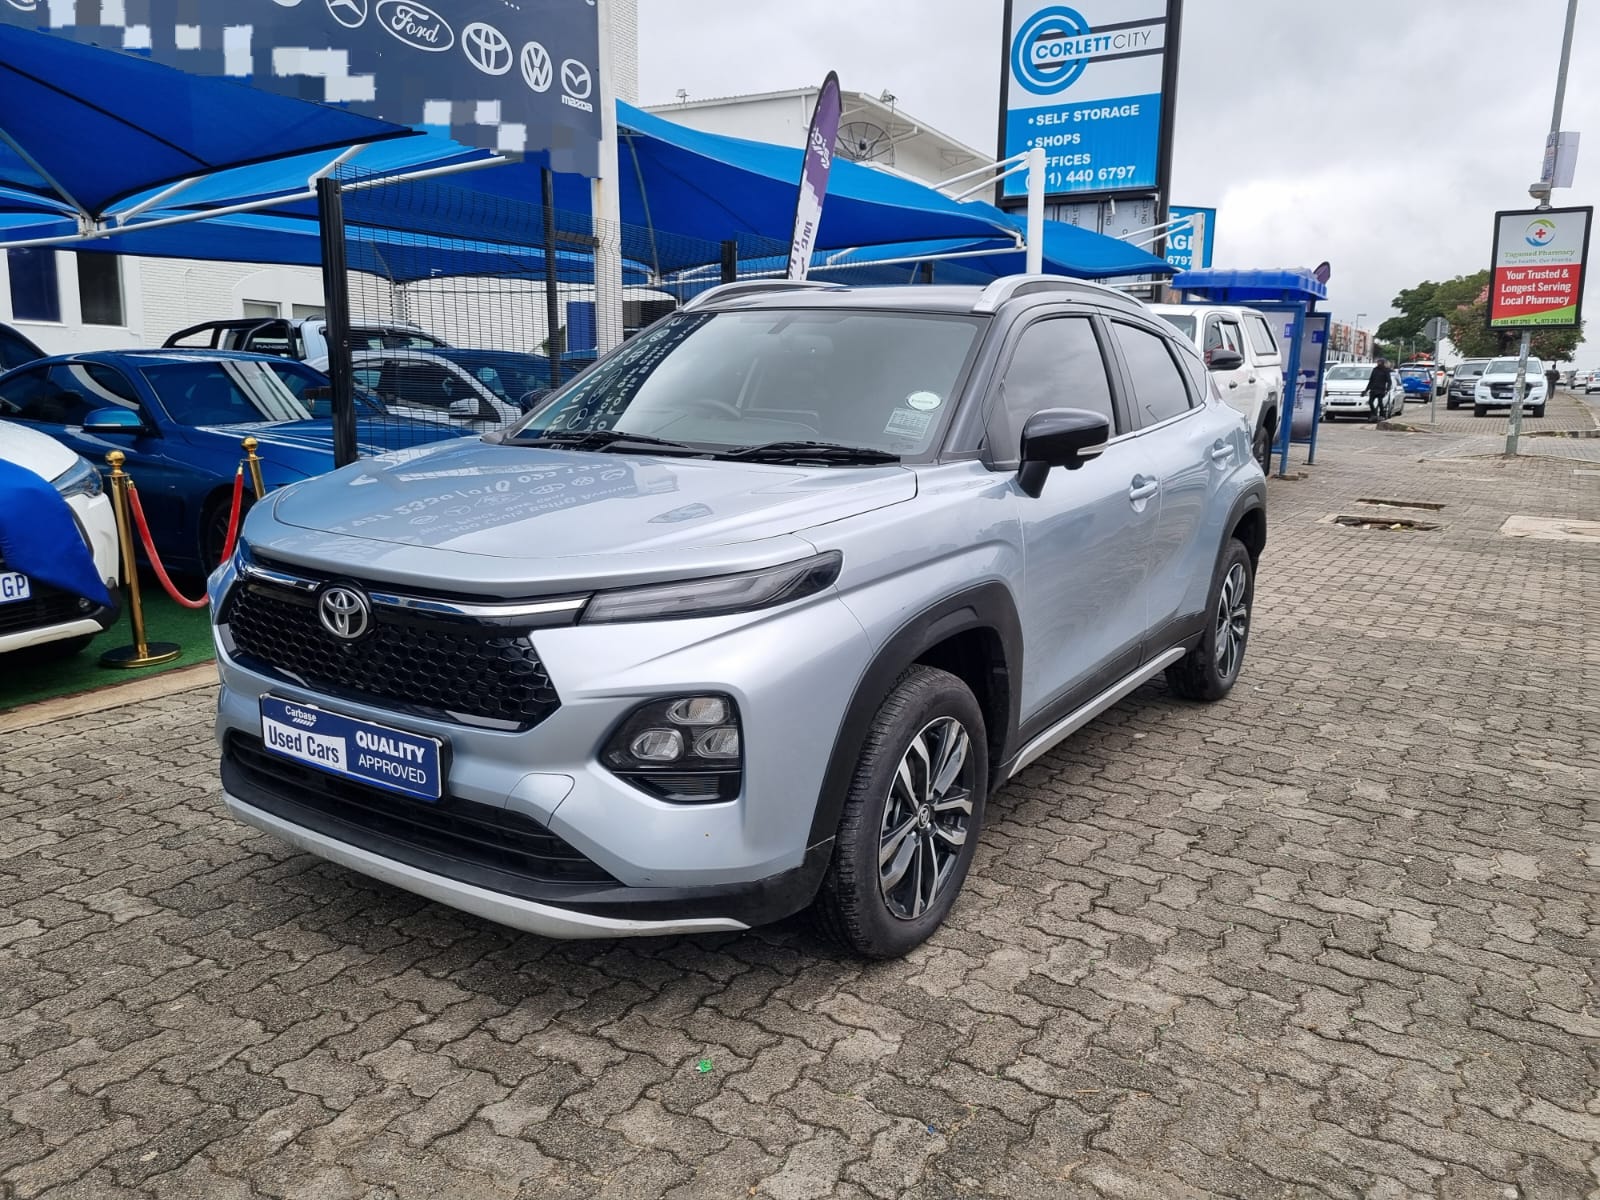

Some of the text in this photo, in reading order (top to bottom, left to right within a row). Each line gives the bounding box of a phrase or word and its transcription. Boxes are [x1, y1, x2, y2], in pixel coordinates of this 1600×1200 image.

[391, 5, 440, 43] Ford
[1036, 104, 1140, 126] SELF STORAGE
[1035, 133, 1081, 148] SHOPS
[1044, 153, 1091, 168] FFICES
[1066, 169, 1093, 183] 440
[1098, 165, 1136, 181] 6797
[1506, 268, 1569, 280] Your Trusted &
[1501, 281, 1572, 295] Longest Serving
[1501, 295, 1570, 306] Local Pharmacy
[2, 574, 26, 598] GP
[285, 705, 317, 722] Carbase
[268, 725, 340, 764] Used Cars
[355, 730, 425, 763] QUALITY
[358, 754, 428, 784] APPROVED
